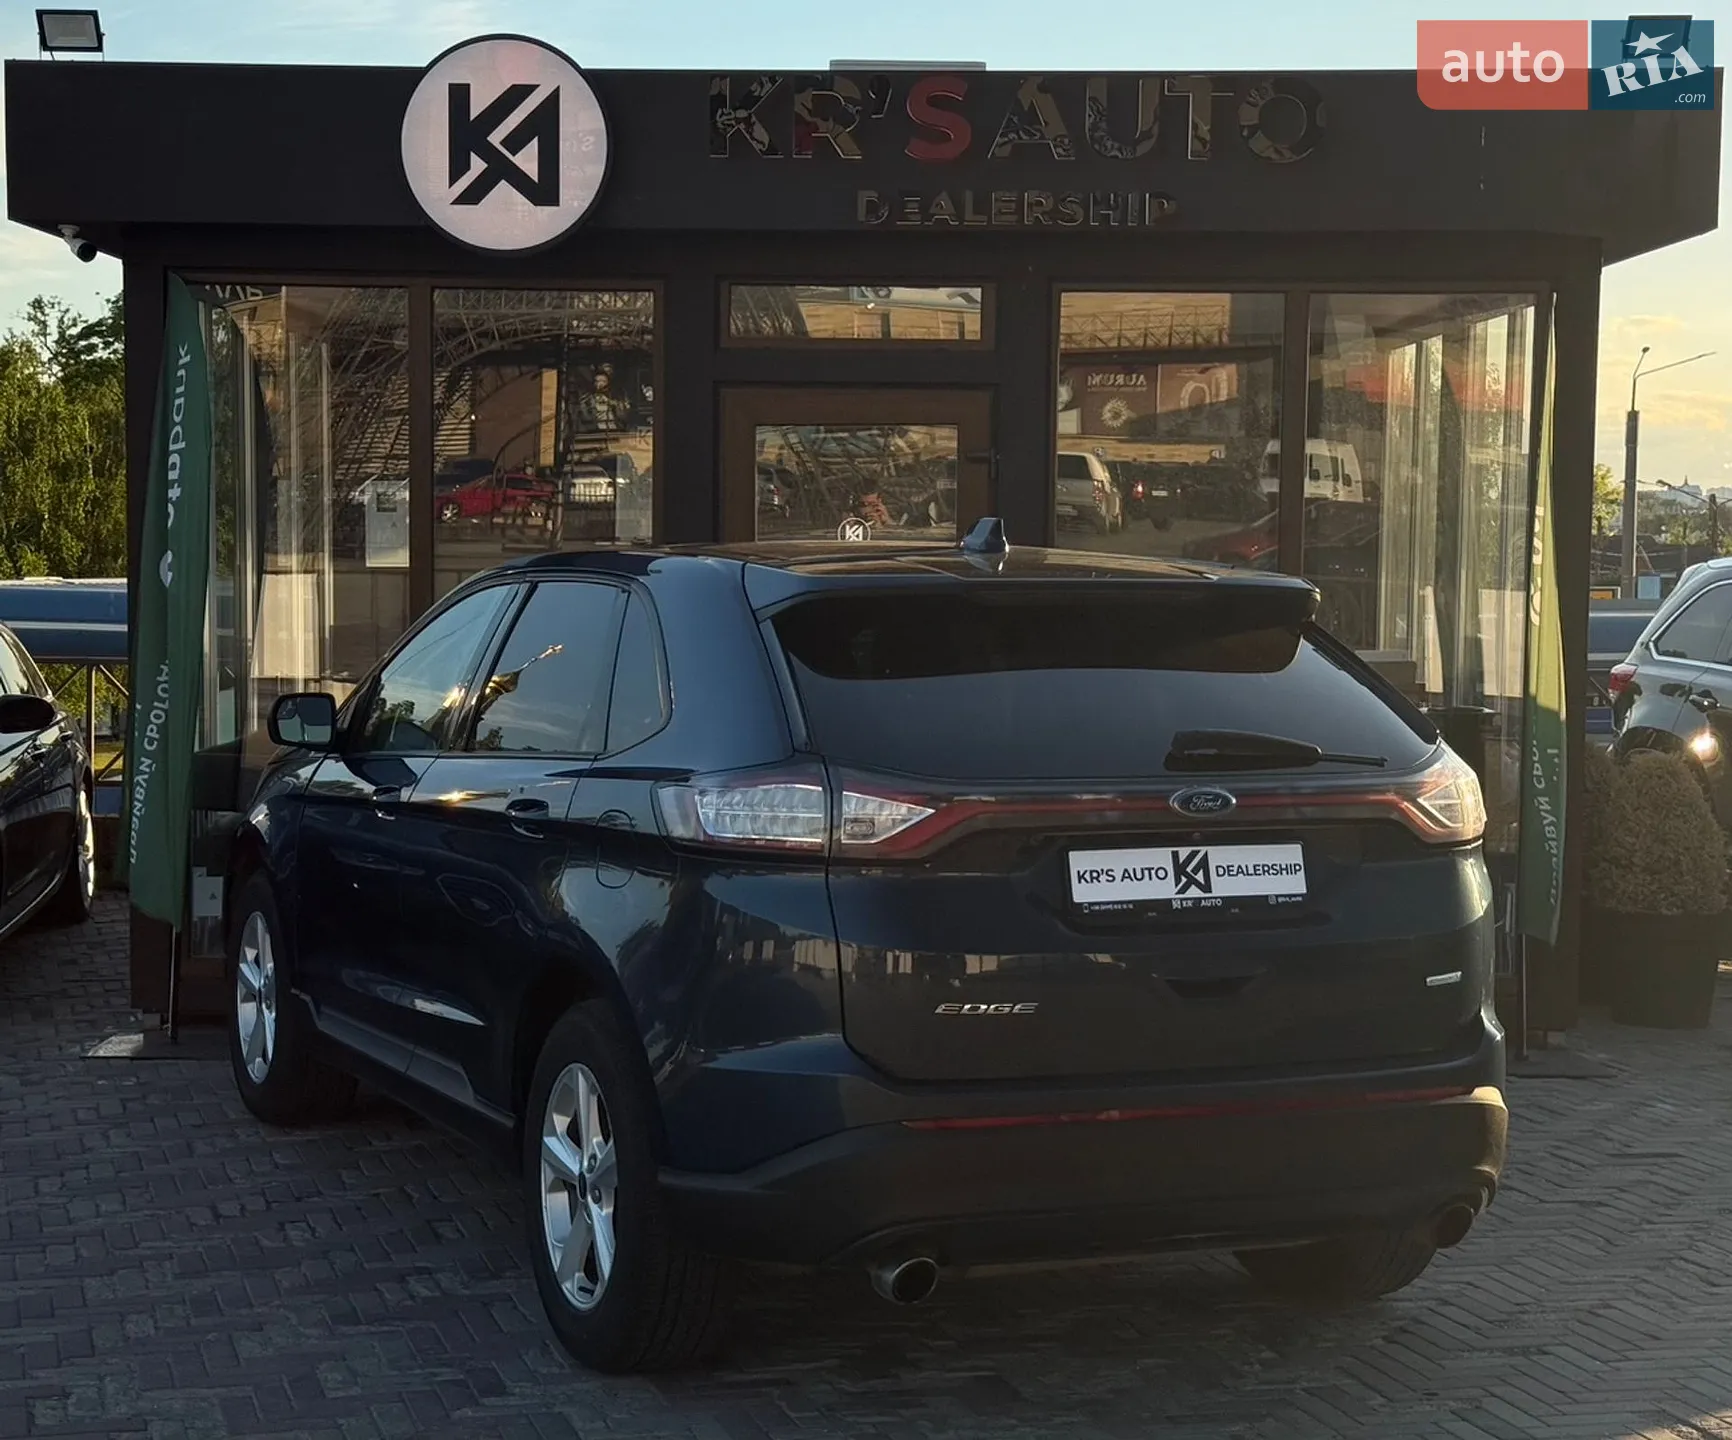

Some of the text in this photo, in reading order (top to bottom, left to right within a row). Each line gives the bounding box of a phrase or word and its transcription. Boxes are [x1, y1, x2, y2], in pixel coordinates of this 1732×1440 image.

[857, 190, 1178, 226] DEALERSHIP
[1077, 868, 1116, 884] KR'S
[1120, 866, 1169, 883] AUTO
[1216, 862, 1303, 879] DEALERSHIP
[1201, 898, 1222, 907] AUTO
[934, 1002, 1039, 1015] EDGE
